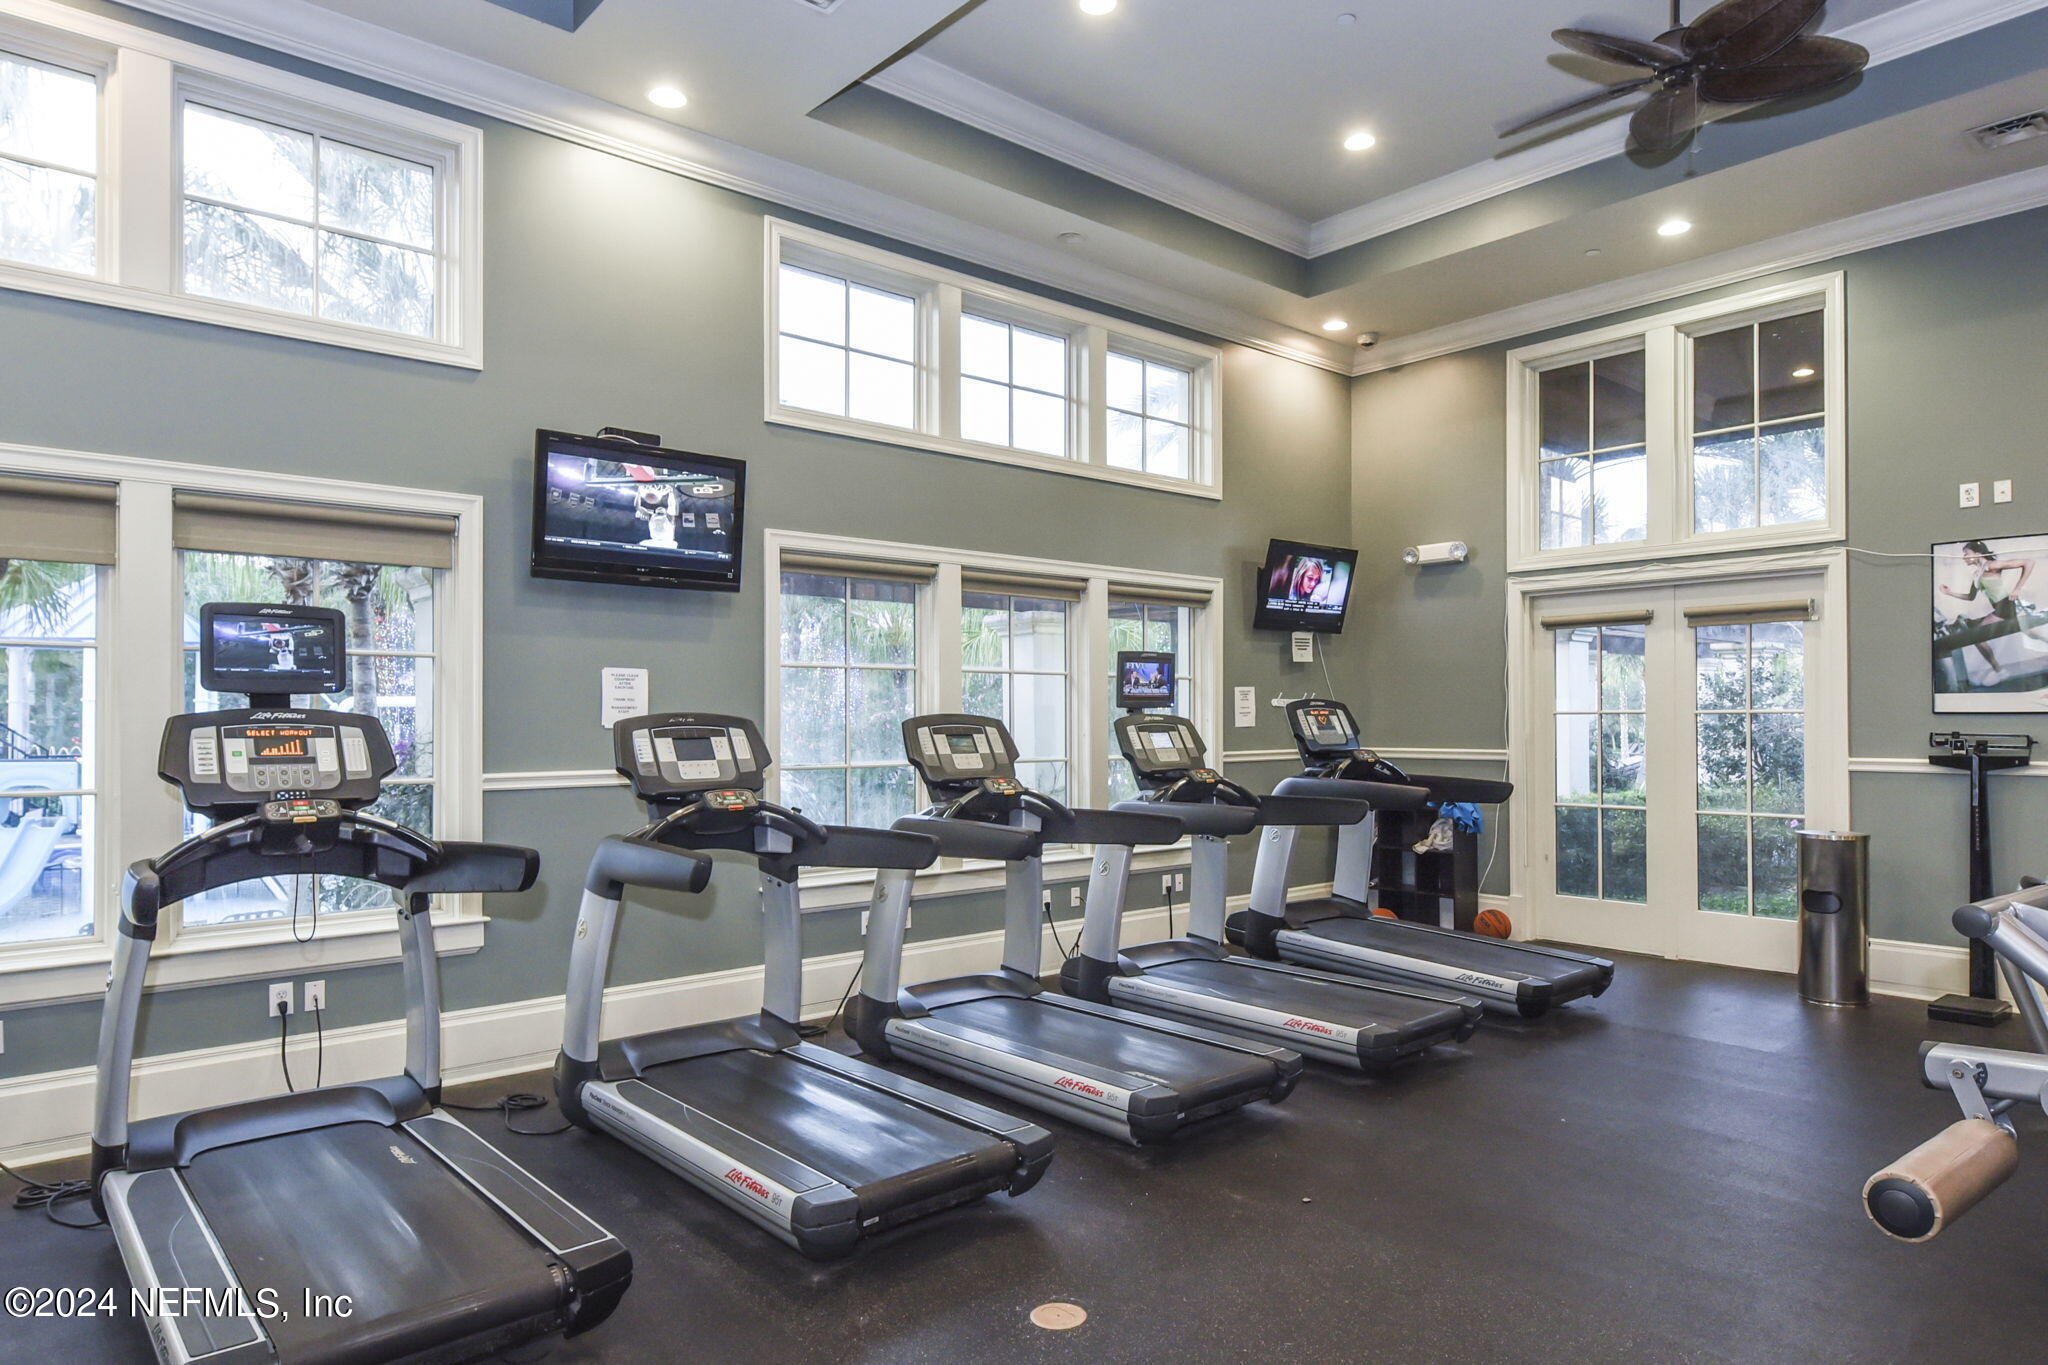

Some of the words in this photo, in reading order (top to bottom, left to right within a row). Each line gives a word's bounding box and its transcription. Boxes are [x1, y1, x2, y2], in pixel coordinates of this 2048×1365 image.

[246, 729, 275, 737] SELECT
[1054, 1076, 1074, 1089] Life
[1071, 1081, 1105, 1098] Fitness
[724, 1168, 743, 1184] Life
[739, 1175, 769, 1199] Fitness
